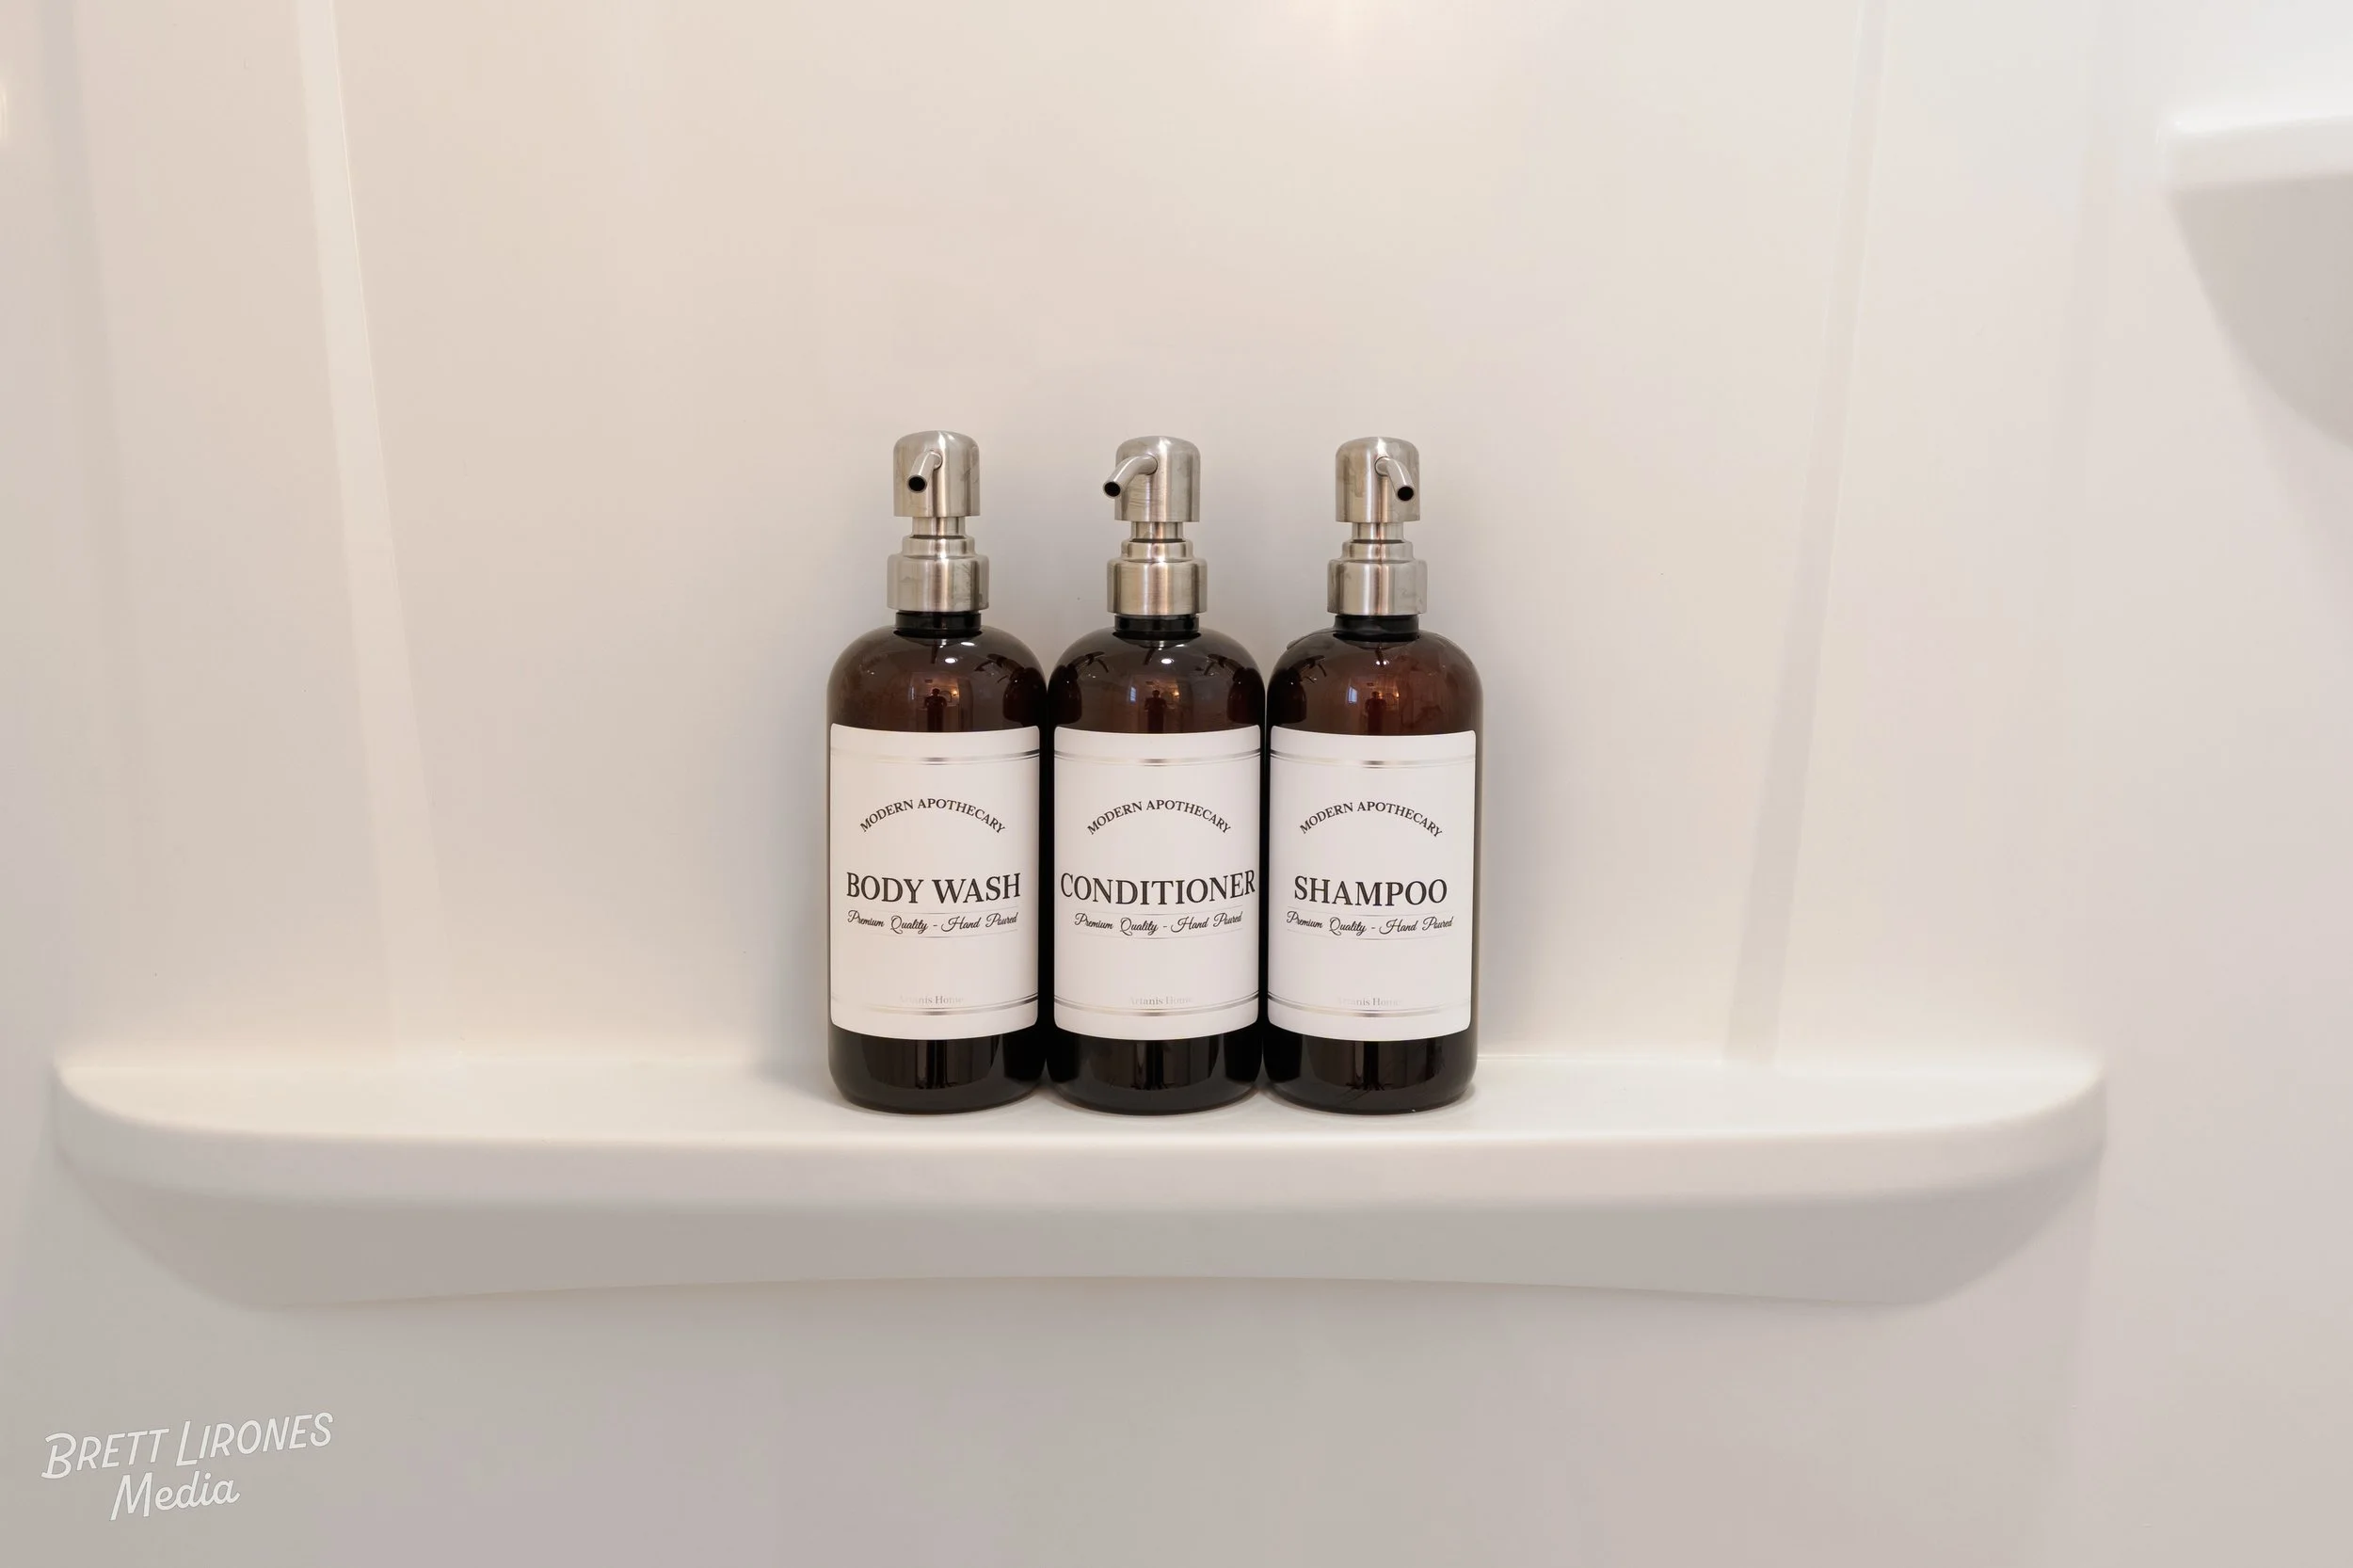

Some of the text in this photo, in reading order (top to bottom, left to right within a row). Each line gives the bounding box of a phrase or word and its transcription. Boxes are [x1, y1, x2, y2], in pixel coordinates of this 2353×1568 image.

[860, 798, 1005, 833] MODERN APOTHECARY
[1087, 800, 1231, 835] MODERN APOTHECARY
[1300, 801, 1442, 837] MODERN APOTHECARY
[846, 872, 1020, 904] BODY WASH
[1061, 870, 1256, 905] CONDITIONER
[1294, 875, 1447, 906] SHAMPOO
[848, 910, 885, 927] Premium
[889, 915, 929, 934] Quality
[941, 916, 982, 932] Hand
[985, 912, 1018, 927] Poured
[1074, 913, 1113, 929] Premium
[1120, 918, 1159, 936] Quality
[1171, 916, 1209, 933] Hand
[1213, 911, 1242, 927] Poured
[1287, 911, 1323, 928] Premium
[1329, 917, 1368, 936] Quality
[1379, 919, 1418, 935] Hand
[1422, 916, 1453, 931] Poured
